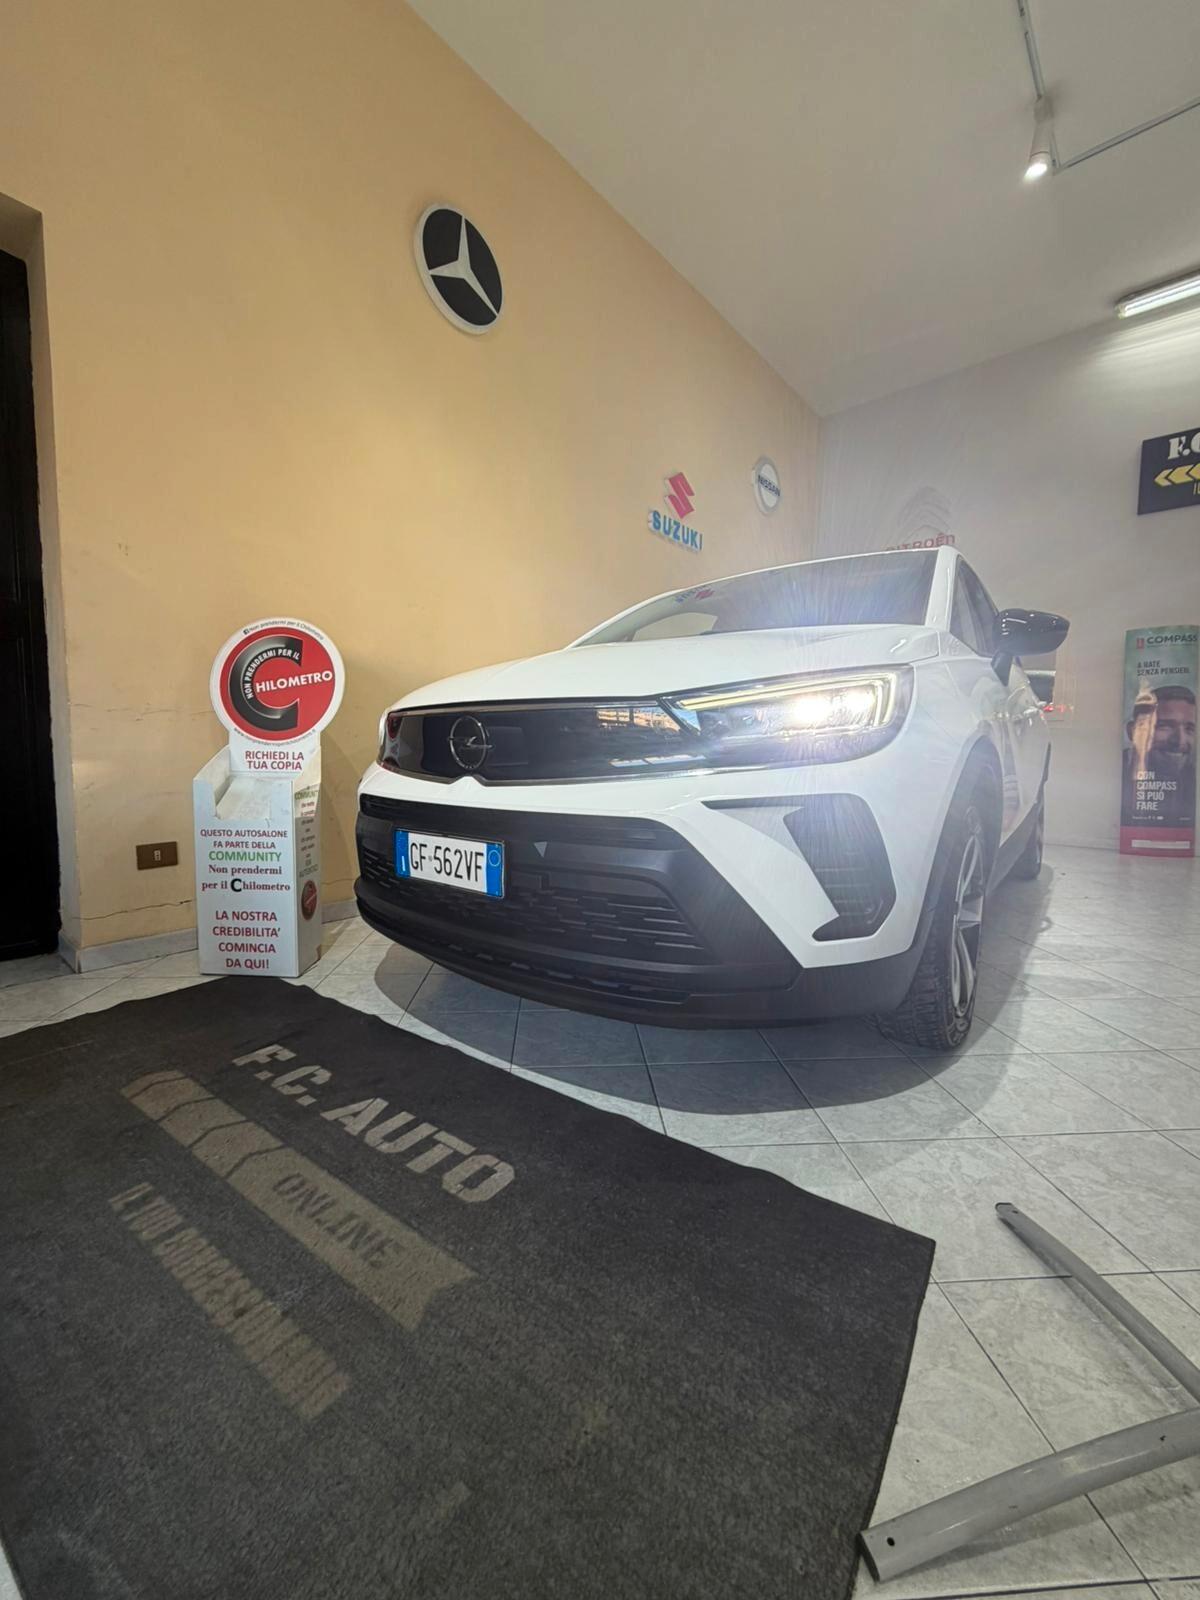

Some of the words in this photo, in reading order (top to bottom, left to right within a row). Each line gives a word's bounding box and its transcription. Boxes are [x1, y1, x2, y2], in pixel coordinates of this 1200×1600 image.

[757, 474, 781, 497] NISSAN
[652, 510, 703, 551] SUZUKI
[1146, 634, 1198, 645] COMPASS
[278, 648, 291, 657] PER
[293, 651, 301, 660] IL
[244, 649, 277, 682] PRENDERMI
[243, 681, 254, 699] NON
[245, 750, 289, 761] RICHIEDI
[292, 751, 304, 761] LA
[247, 761, 268, 770] TUA
[271, 761, 302, 771] COPIA
[1136, 781, 1177, 791] COMPASS
[1136, 801, 1159, 811] FARE
[200, 829, 232, 838] QUESTO
[234, 829, 288, 838] AUTOSALONE
[213, 841, 223, 849] FA
[225, 841, 249, 849] PARTE
[251, 841, 276, 849] DELLA
[208, 850, 282, 862] COMMUNITY
[208, 864, 228, 874] Non
[231, 865, 282, 876] prendermi
[201, 882, 219, 891] per
[220, 880, 228, 890] il
[215, 910, 229, 921] LA
[231, 911, 278, 922] NOSTRA
[218, 942, 277, 954] COMINCIA
[226, 958, 242, 969] DA
[244, 958, 269, 970] QUI!
[320, 1097, 515, 1203] AUTO
[272, 1172, 397, 1269] ONLINE
